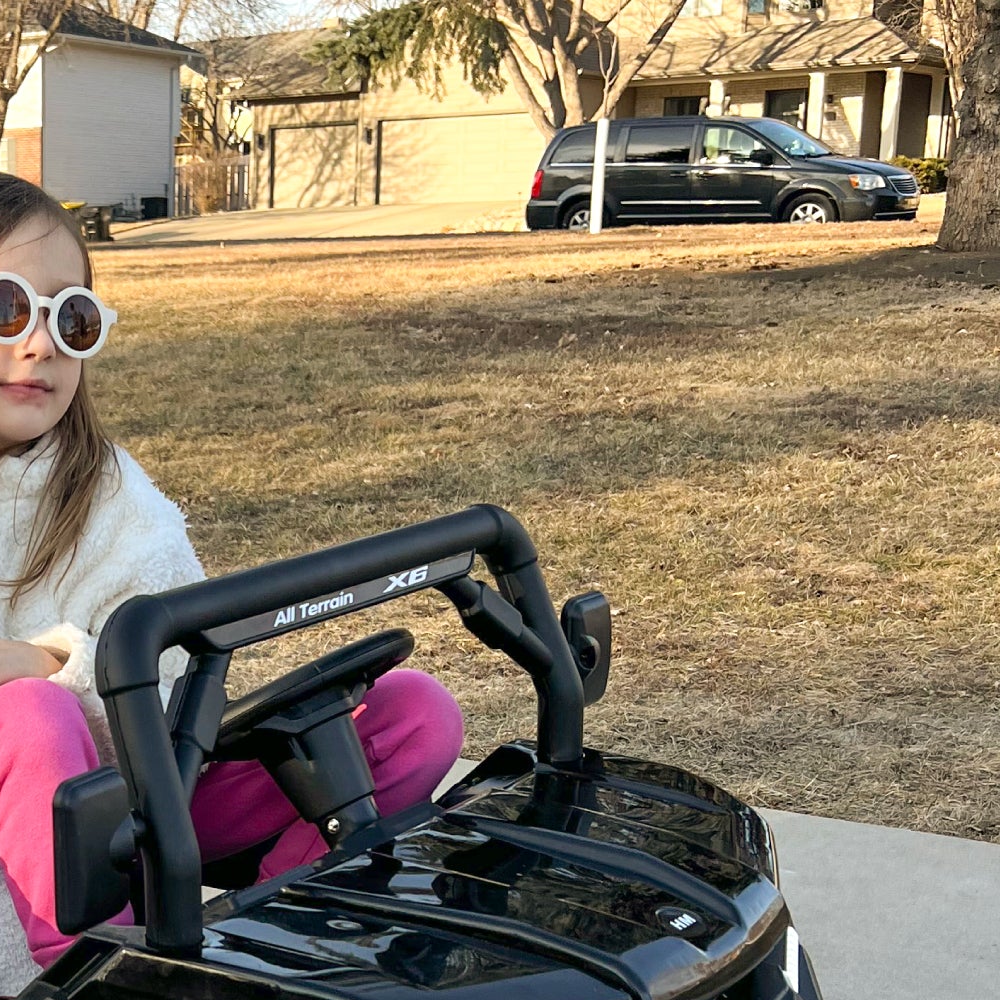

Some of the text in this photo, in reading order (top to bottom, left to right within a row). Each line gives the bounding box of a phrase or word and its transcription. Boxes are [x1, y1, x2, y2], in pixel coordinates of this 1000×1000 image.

[273, 565, 429, 628] All Terrain X6
[669, 913, 697, 931] HM
